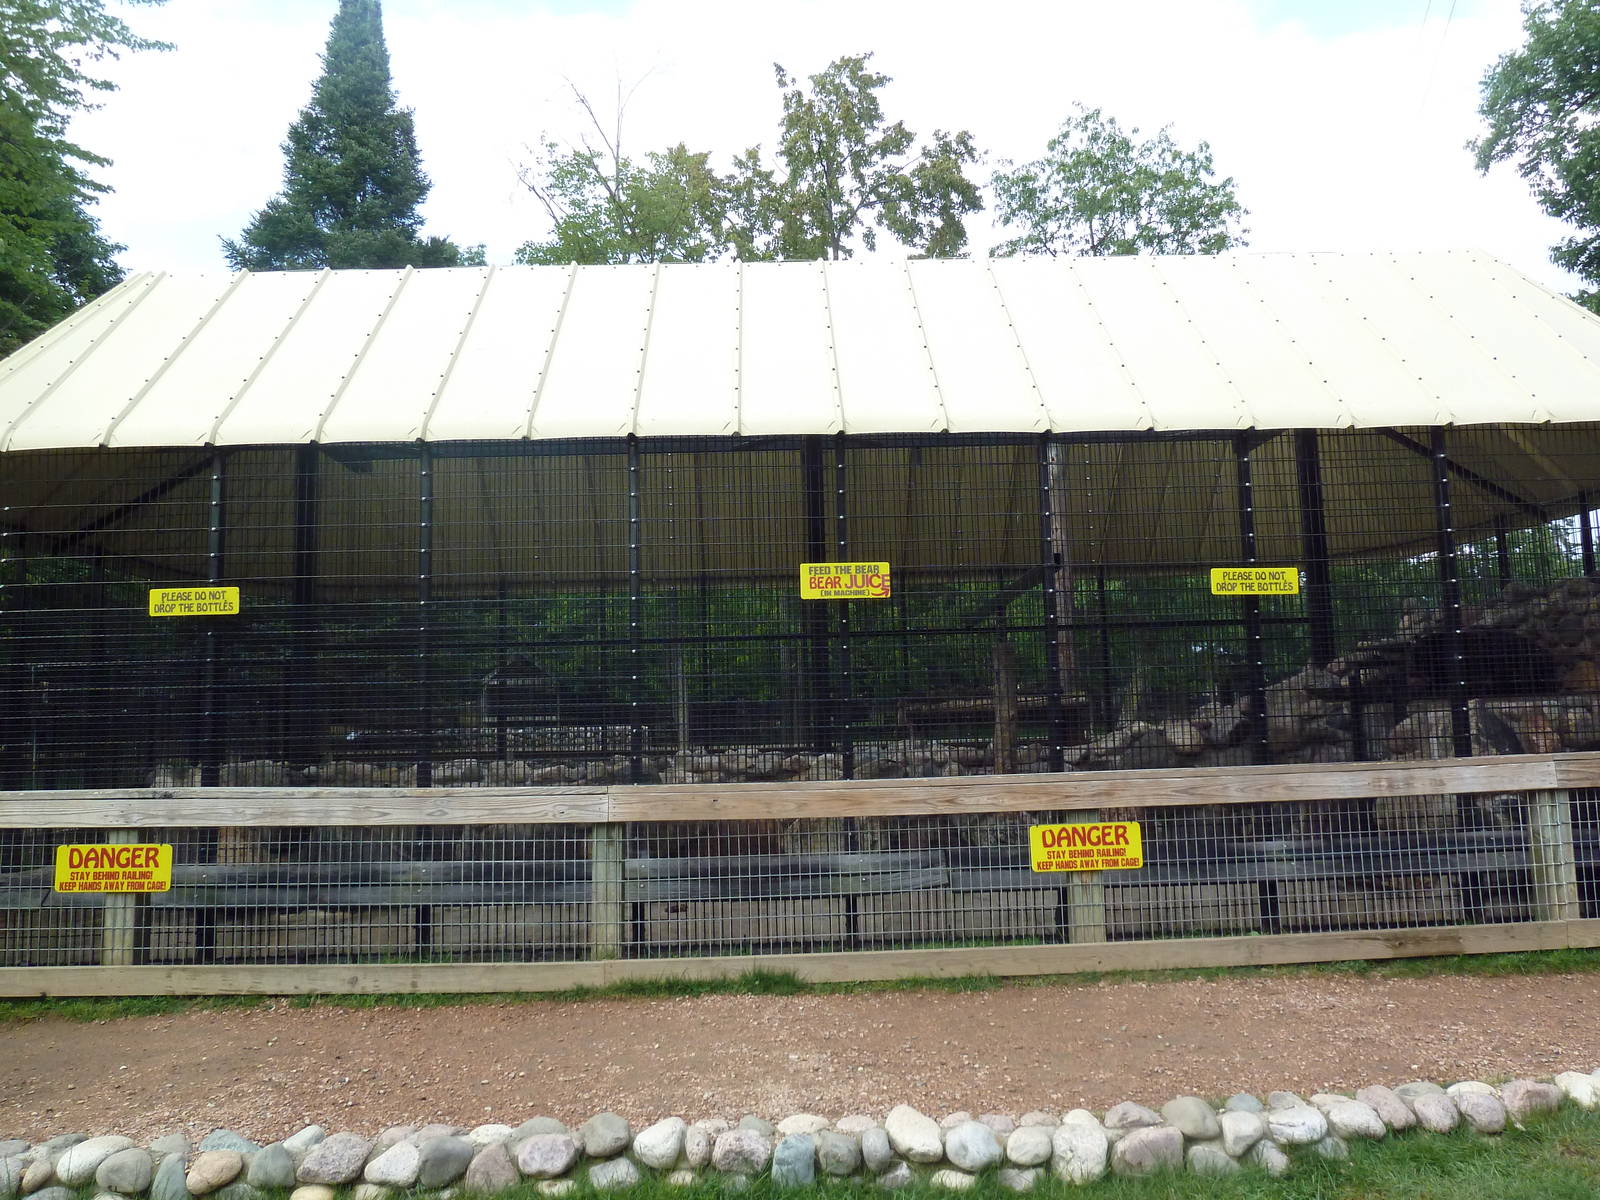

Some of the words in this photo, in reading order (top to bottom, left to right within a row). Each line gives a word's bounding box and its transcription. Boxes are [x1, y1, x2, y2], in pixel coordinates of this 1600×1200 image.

[809, 566, 830, 575] FEED
[835, 566, 851, 574] THE
[855, 565, 879, 574] BEAR
[1223, 572, 1252, 580] PLEASE
[1255, 572, 1266, 580] DO
[1269, 572, 1286, 580] NOT
[810, 576, 841, 589] BEAR
[845, 574, 890, 589] JUICE
[1217, 583, 1237, 591] DROP
[1241, 583, 1255, 591] THE
[1258, 583, 1293, 591] BOTTLES
[162, 592, 192, 601] PLEASE
[195, 592, 206, 600] DO
[209, 591, 226, 600] NOT
[154, 604, 176, 613] DROP
[179, 603, 194, 612] THE
[197, 602, 233, 611] BOTTLES
[1042, 825, 1129, 848] DANGER
[69, 848, 159, 868] DANGER
[1047, 850, 1066, 859] STAY
[1069, 849, 1094, 858] BEHIND
[1097, 848, 1126, 857] RAILING!
[1037, 861, 1053, 870] KEEP
[1056, 860, 1077, 869] HANDS
[1080, 860, 1100, 868] AWAY
[1102, 859, 1119, 867] FROM
[1121, 858, 1139, 867] CAGE!
[70, 872, 90, 880] STAY
[93, 871, 120, 880] BEHIND
[122, 871, 153, 879] RAILING!
[59, 882, 76, 890] KEEP
[79, 882, 101, 890] HANDS
[104, 882, 124, 890] AWAY
[127, 881, 145, 890] FROM
[147, 881, 166, 890] CAGE!
